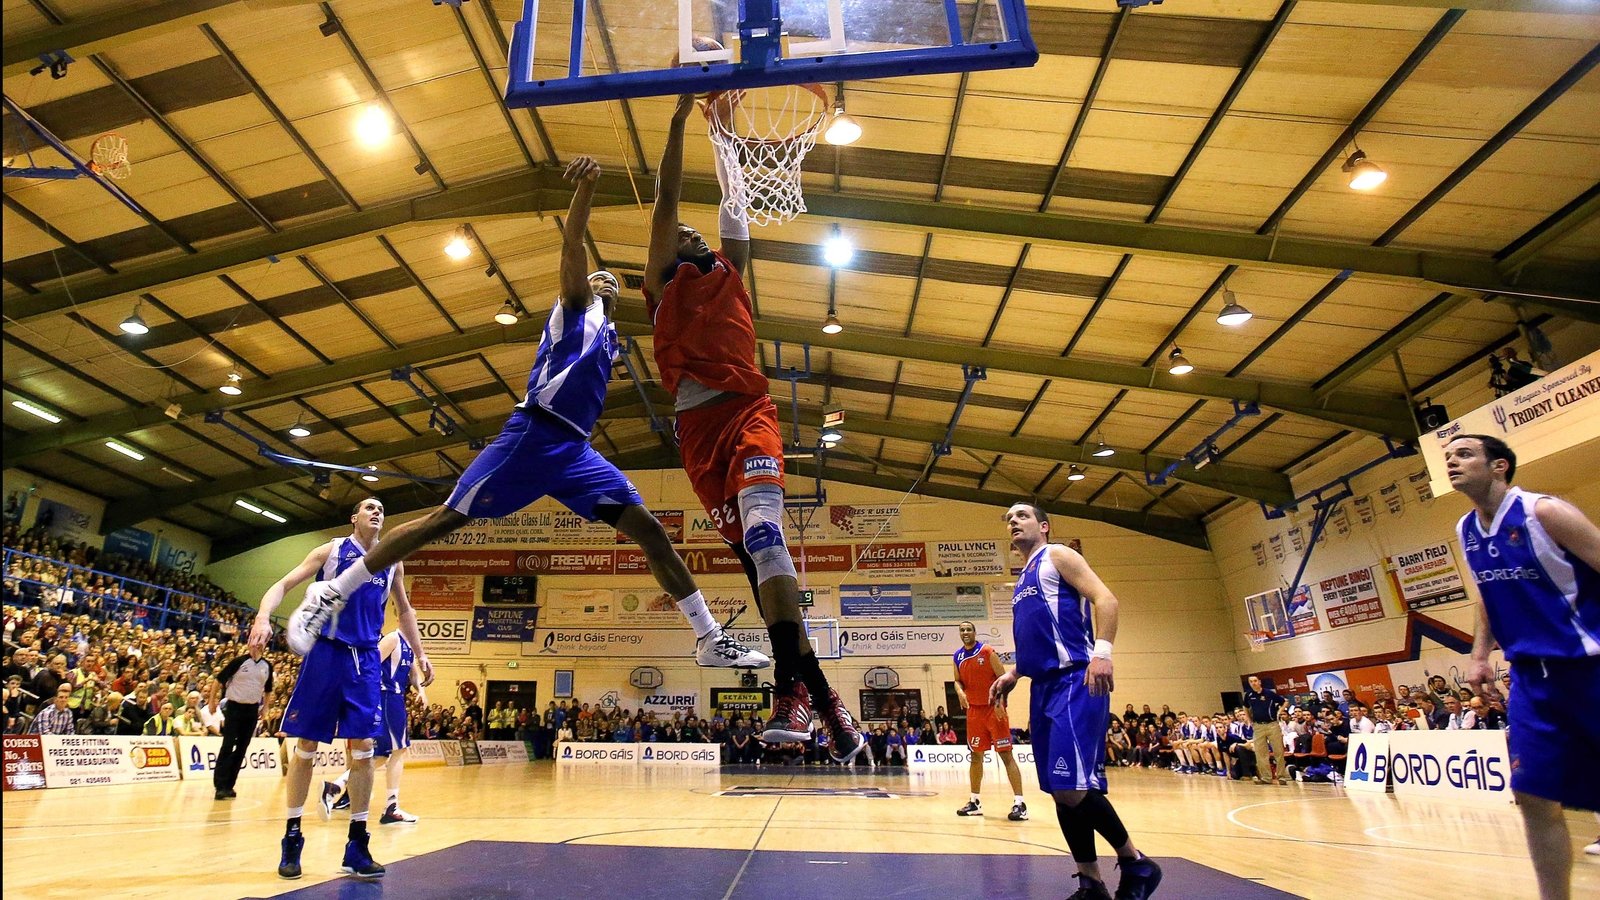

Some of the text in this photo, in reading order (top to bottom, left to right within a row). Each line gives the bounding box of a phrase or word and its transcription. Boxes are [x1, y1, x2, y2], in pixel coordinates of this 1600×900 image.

[1542, 370, 1578, 393] Sponsored
[1578, 364, 1592, 376] By
[1509, 398, 1554, 427] TRIDENT
[1436, 422, 1461, 439] NEPTUNE
[746, 460, 778, 470] NIVEA
[490, 512, 552, 526] Northside Glass Ltd.
[711, 504, 735, 528] 32
[554, 518, 582, 528] 24HR
[964, 542, 996, 550] LYNCH
[1488, 541, 1499, 558] 6
[860, 548, 923, 559] McGARRY
[1398, 545, 1448, 567] BARRY FIELD
[1404, 558, 1447, 575] CRASH REPAIRS
[1320, 568, 1370, 592] NEPTUNE BINGO
[805, 592, 811, 601] 9
[710, 596, 746, 608] Anglers
[488, 611, 524, 619] NEPTUNE
[557, 632, 643, 644] Bord Gáis Energy
[738, 632, 760, 642] Gáis
[851, 631, 944, 642] Bord Gáis Energy
[579, 643, 607, 652] beyond
[876, 643, 906, 652] beyond
[644, 696, 694, 705] AZZURRI
[4, 739, 38, 748] CORK'S
[971, 737, 980, 745] 13
[4, 751, 21, 760] No.
[70, 748, 122, 756] CONSULTATION
[575, 749, 633, 759] BORD GÁIS
[657, 749, 715, 760] BORD GÁIS
[76, 757, 119, 766] MEASURING
[208, 749, 277, 770] BD GÁIS
[328, 749, 345, 766] GÁIS
[928, 753, 992, 763] BORD GS
[1018, 753, 1035, 762] BO
[5, 762, 43, 772] SPORTS
[1373, 750, 1506, 792] BORD GÁIS
